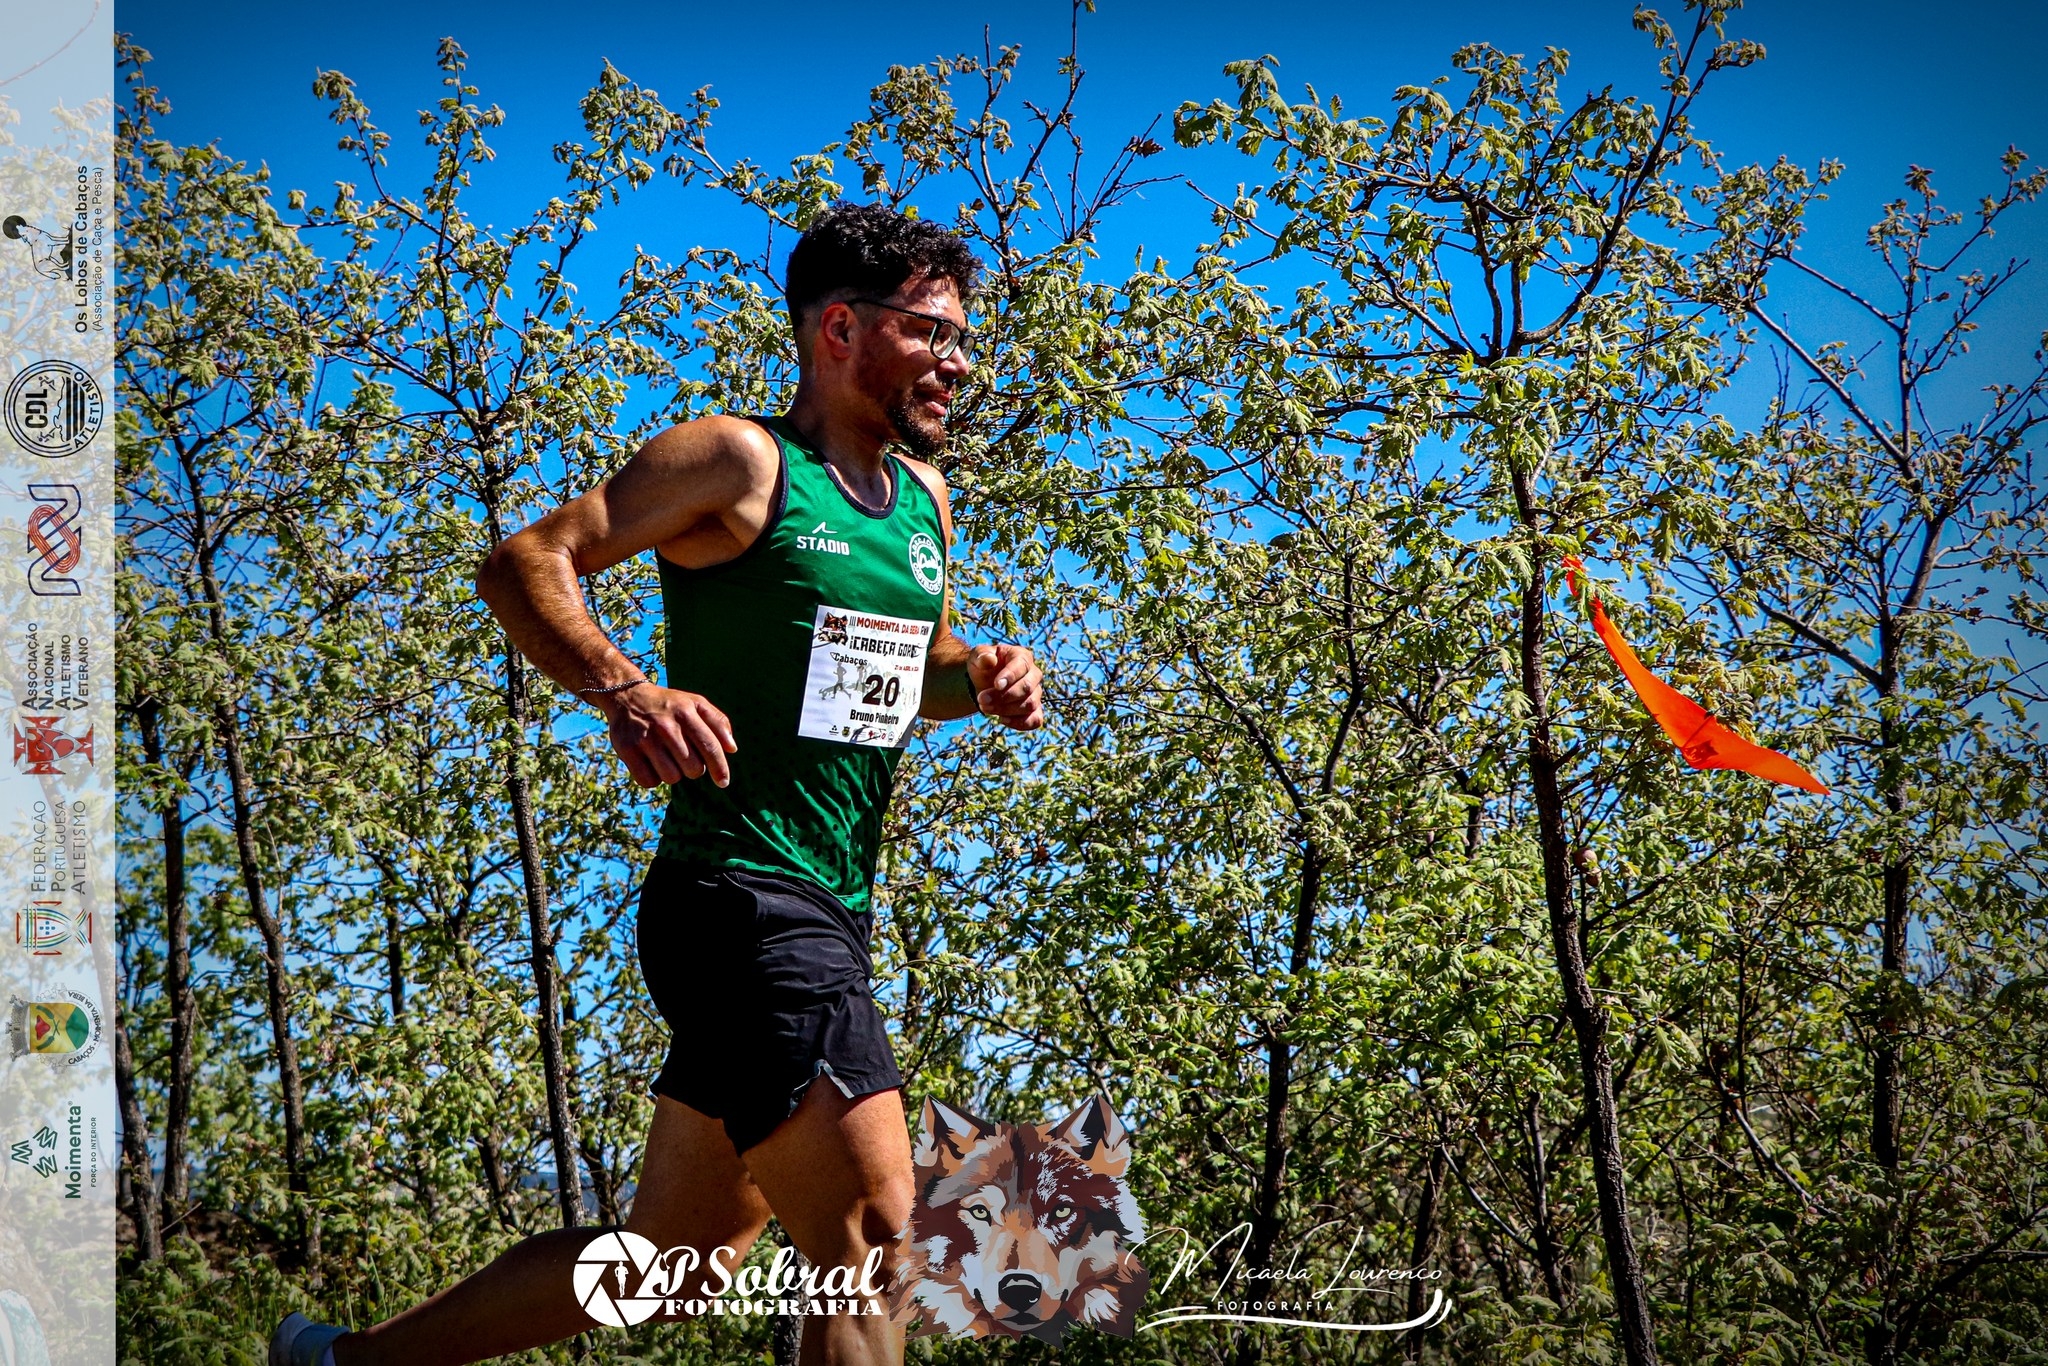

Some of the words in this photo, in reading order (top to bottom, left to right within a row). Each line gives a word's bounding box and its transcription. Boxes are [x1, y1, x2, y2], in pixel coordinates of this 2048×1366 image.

[796, 535, 850, 556] STADIO
[856, 616, 900, 633] MOIMENTA
[834, 652, 868, 666] Cabaços
[862, 674, 900, 707] 20
[849, 708, 875, 722] Bruno
[875, 711, 900, 725] Pinheiro
